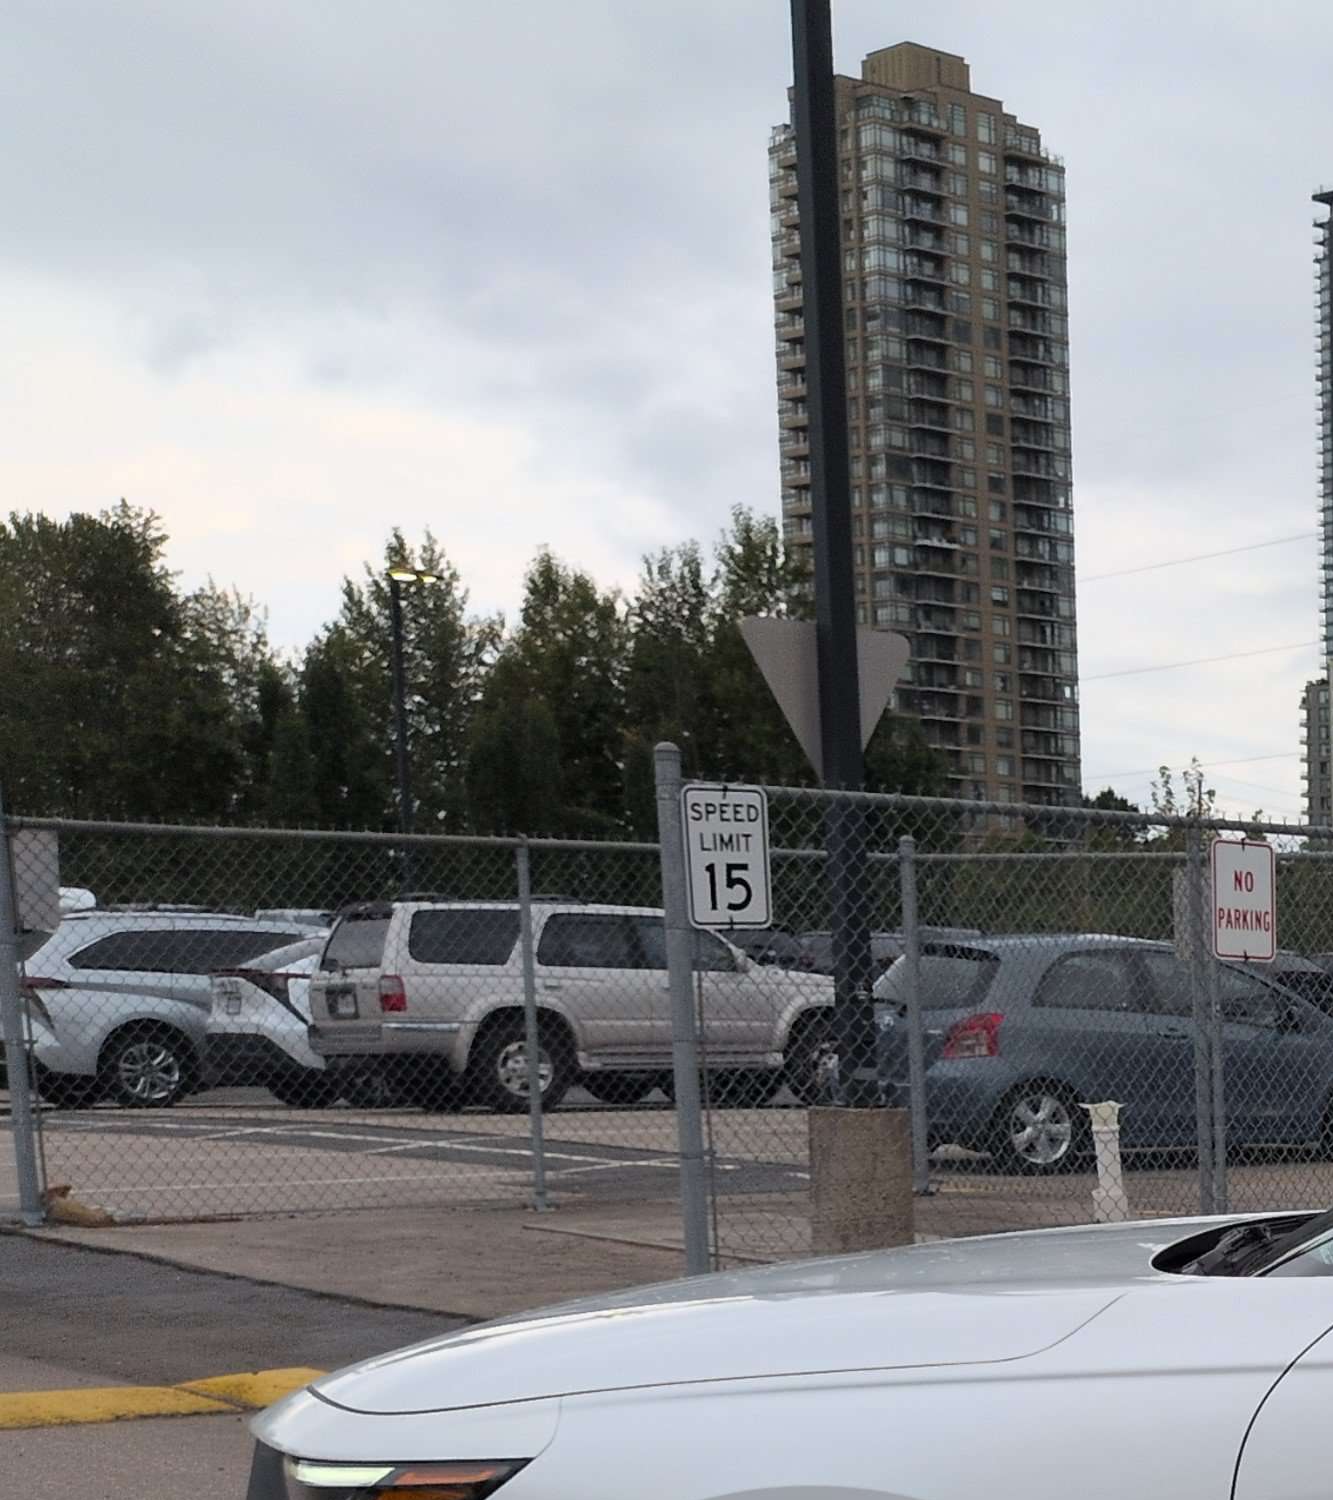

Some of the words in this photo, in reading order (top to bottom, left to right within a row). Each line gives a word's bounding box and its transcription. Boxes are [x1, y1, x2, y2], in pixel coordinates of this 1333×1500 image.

[690, 802, 760, 823] SPEED
[699, 832, 753, 852] LIMIT
[704, 862, 753, 911] 15
[1234, 870, 1254, 893] NO
[1218, 907, 1270, 932] PARKING
